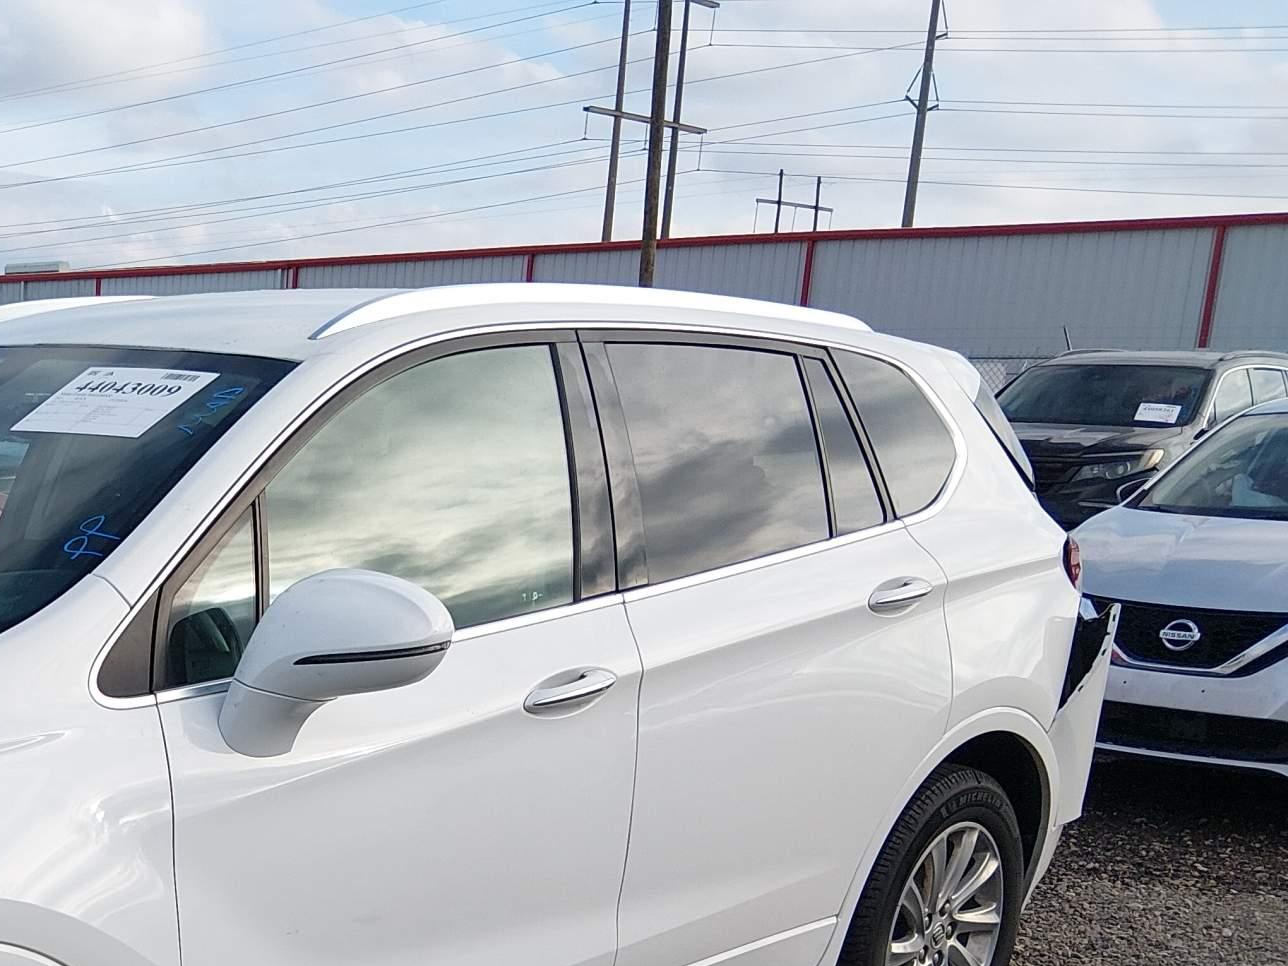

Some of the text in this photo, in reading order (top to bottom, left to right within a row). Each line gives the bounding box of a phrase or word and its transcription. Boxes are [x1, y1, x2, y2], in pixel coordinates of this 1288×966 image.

[75, 380, 182, 397] 44043009
[1162, 631, 1195, 640] NISSAN
[959, 791, 1001, 808] MICHELIN
